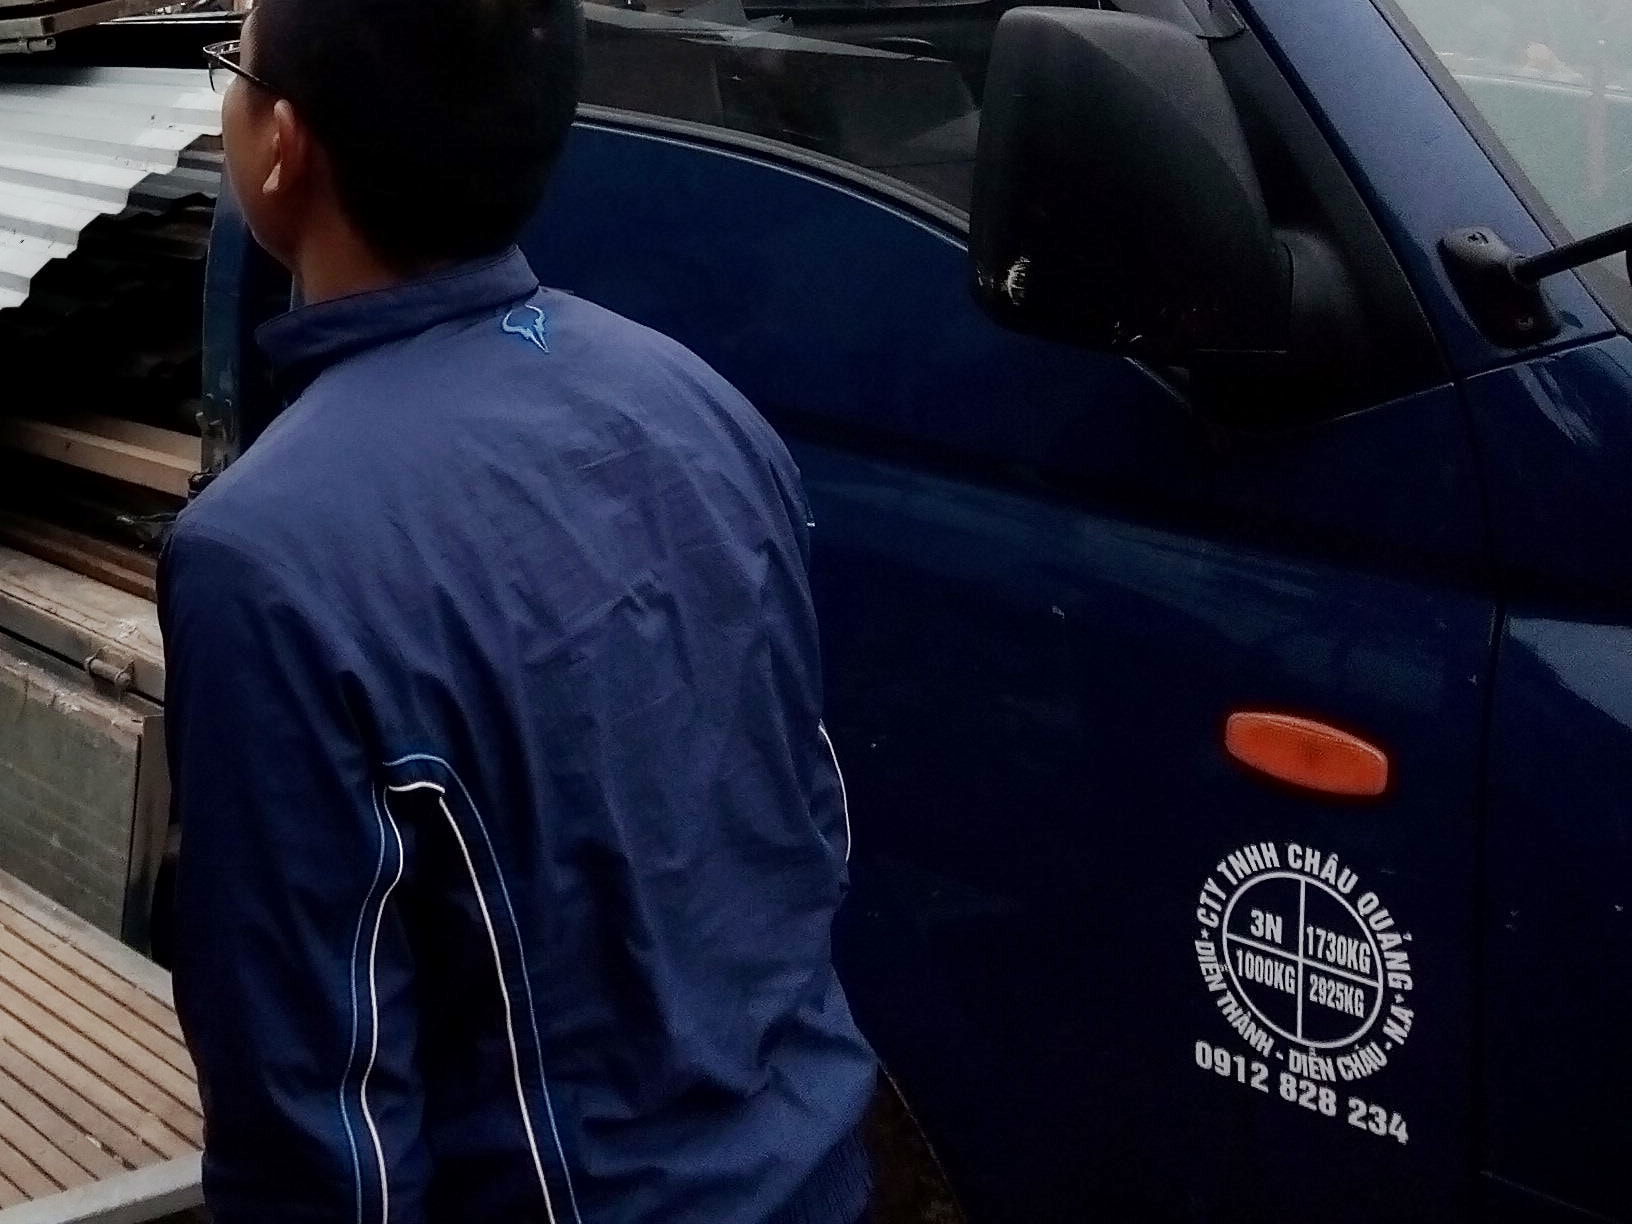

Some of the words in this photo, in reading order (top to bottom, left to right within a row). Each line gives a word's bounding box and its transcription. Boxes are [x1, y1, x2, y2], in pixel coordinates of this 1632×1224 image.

[1196, 877, 1227, 929] CTY
[1216, 842, 1280, 887] TNHH
[1287, 843, 1359, 895] CHÂU
[1356, 891, 1414, 992] QUẢNG
[1250, 909, 1283, 944] 3N
[1236, 949, 1296, 995] 1000KG
[1306, 926, 1372, 975] 1730KG
[1309, 974, 1365, 1019] 2925KG
[1195, 1039, 1270, 1094] 0912
[1279, 1071, 1338, 1118] 828
[1347, 1096, 1410, 1147] 234
